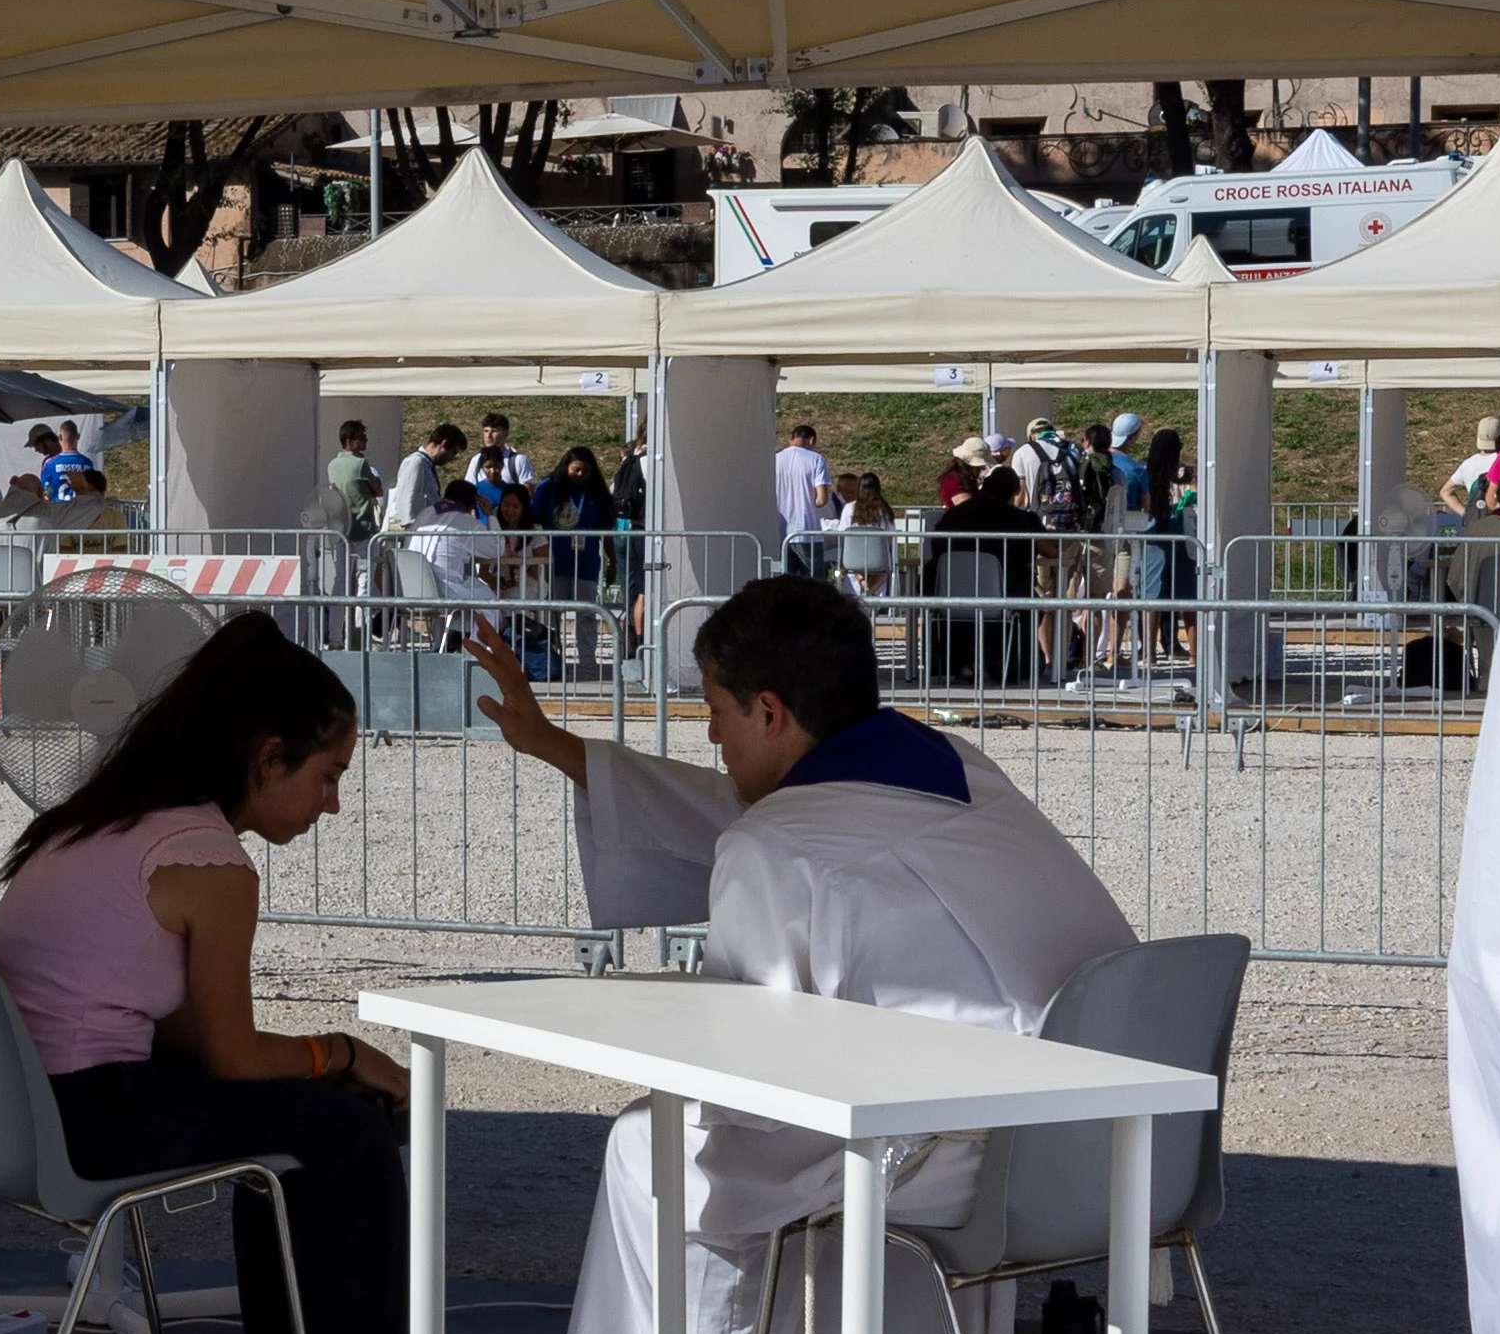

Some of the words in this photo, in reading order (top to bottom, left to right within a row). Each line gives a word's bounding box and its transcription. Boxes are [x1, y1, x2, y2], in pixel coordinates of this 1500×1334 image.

[1214, 185, 1271, 201] CROCE
[1276, 183, 1333, 198] ROSSA
[1338, 178, 1412, 195] ITALIANA
[949, 368, 957, 379] 3
[1324, 363, 1333, 374] 4
[595, 372, 603, 384] 2
